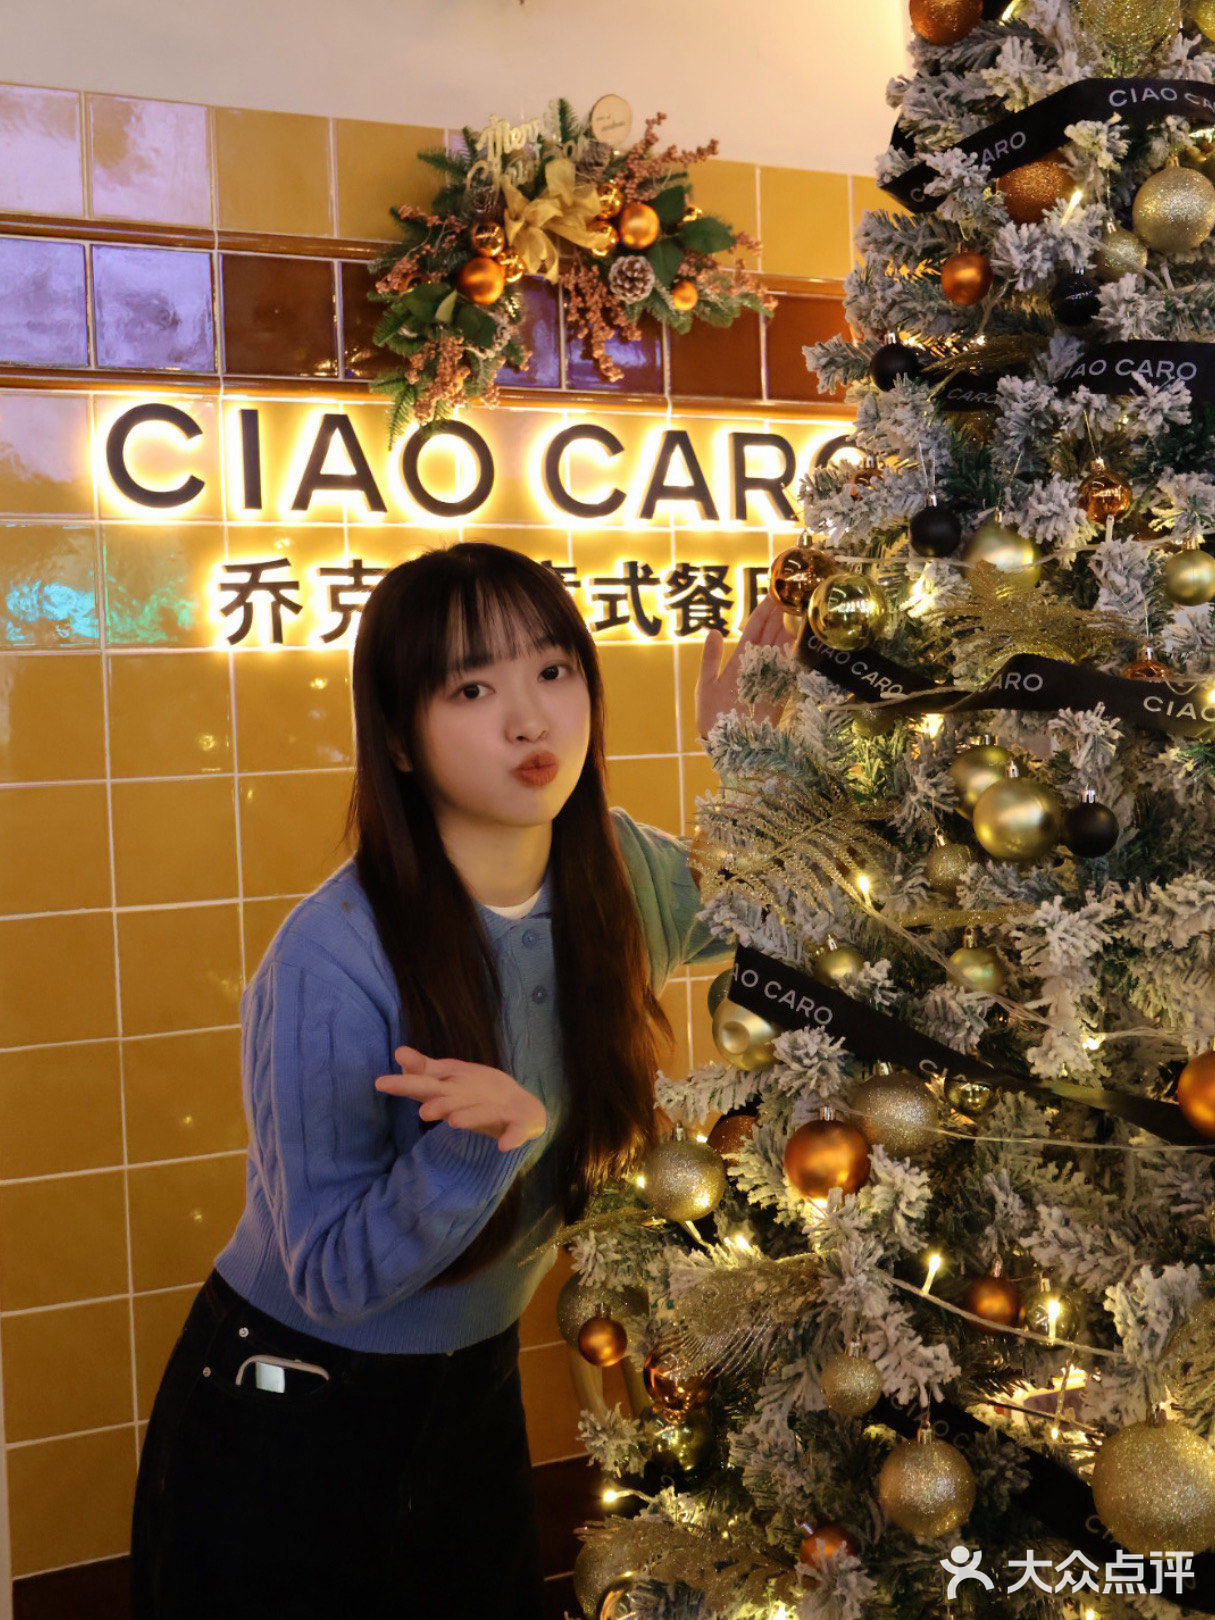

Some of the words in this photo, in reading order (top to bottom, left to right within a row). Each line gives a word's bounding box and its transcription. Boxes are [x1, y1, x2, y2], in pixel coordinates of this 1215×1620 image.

[1108, 87, 1178, 107] CIAO
[1184, 92, 1215, 114] CA
[977, 130, 1027, 169] ARO
[1063, 359, 1108, 379] IAO
[1114, 358, 1198, 381] CARO
[105, 402, 496, 518] CIAO
[987, 671, 1044, 692] ARO
[763, 980, 834, 1025] CARO
